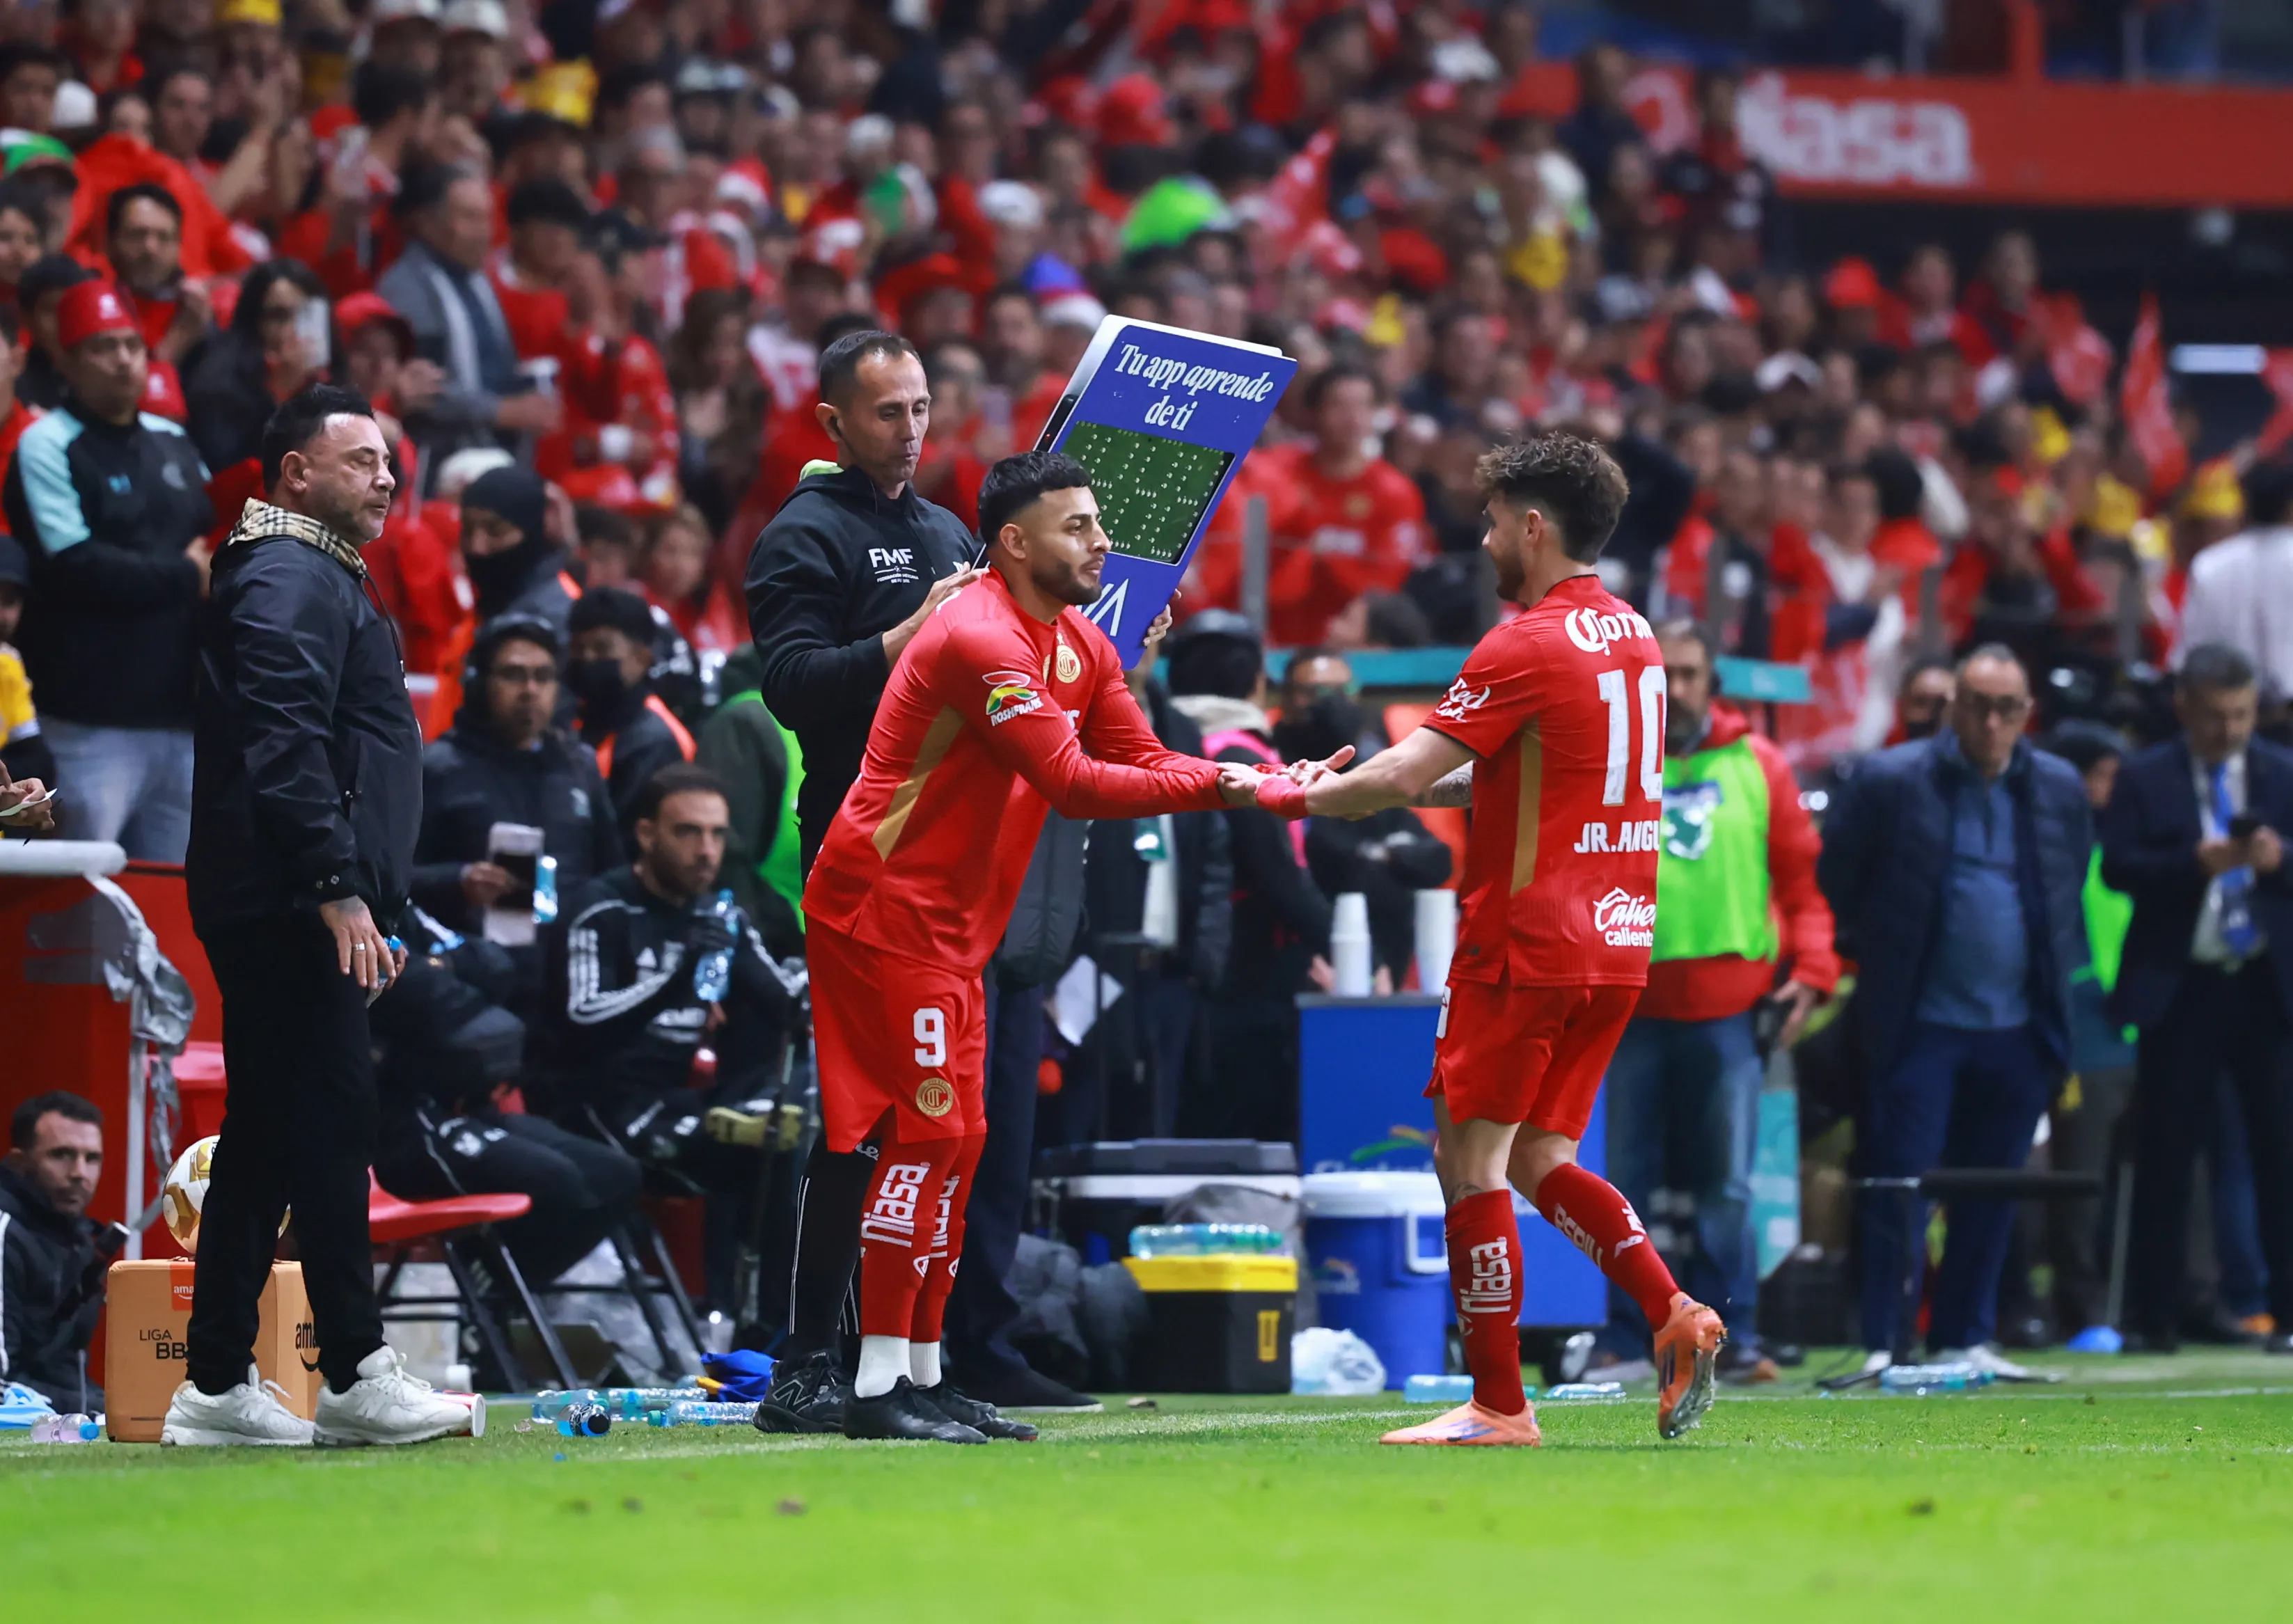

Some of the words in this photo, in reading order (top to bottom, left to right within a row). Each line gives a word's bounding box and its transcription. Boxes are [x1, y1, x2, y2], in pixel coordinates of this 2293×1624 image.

[1114, 344, 1148, 375] Tu
[1143, 356, 1188, 391] app
[1182, 365, 1273, 402] aprende
[1144, 395, 1175, 427] de
[1171, 401, 1199, 431] ti
[868, 548, 913, 568] FMF
[1597, 665, 1667, 806] 10
[913, 1007, 946, 1067] 9
[140, 1329, 172, 1341] LIGA
[157, 1342, 187, 1359] BB
